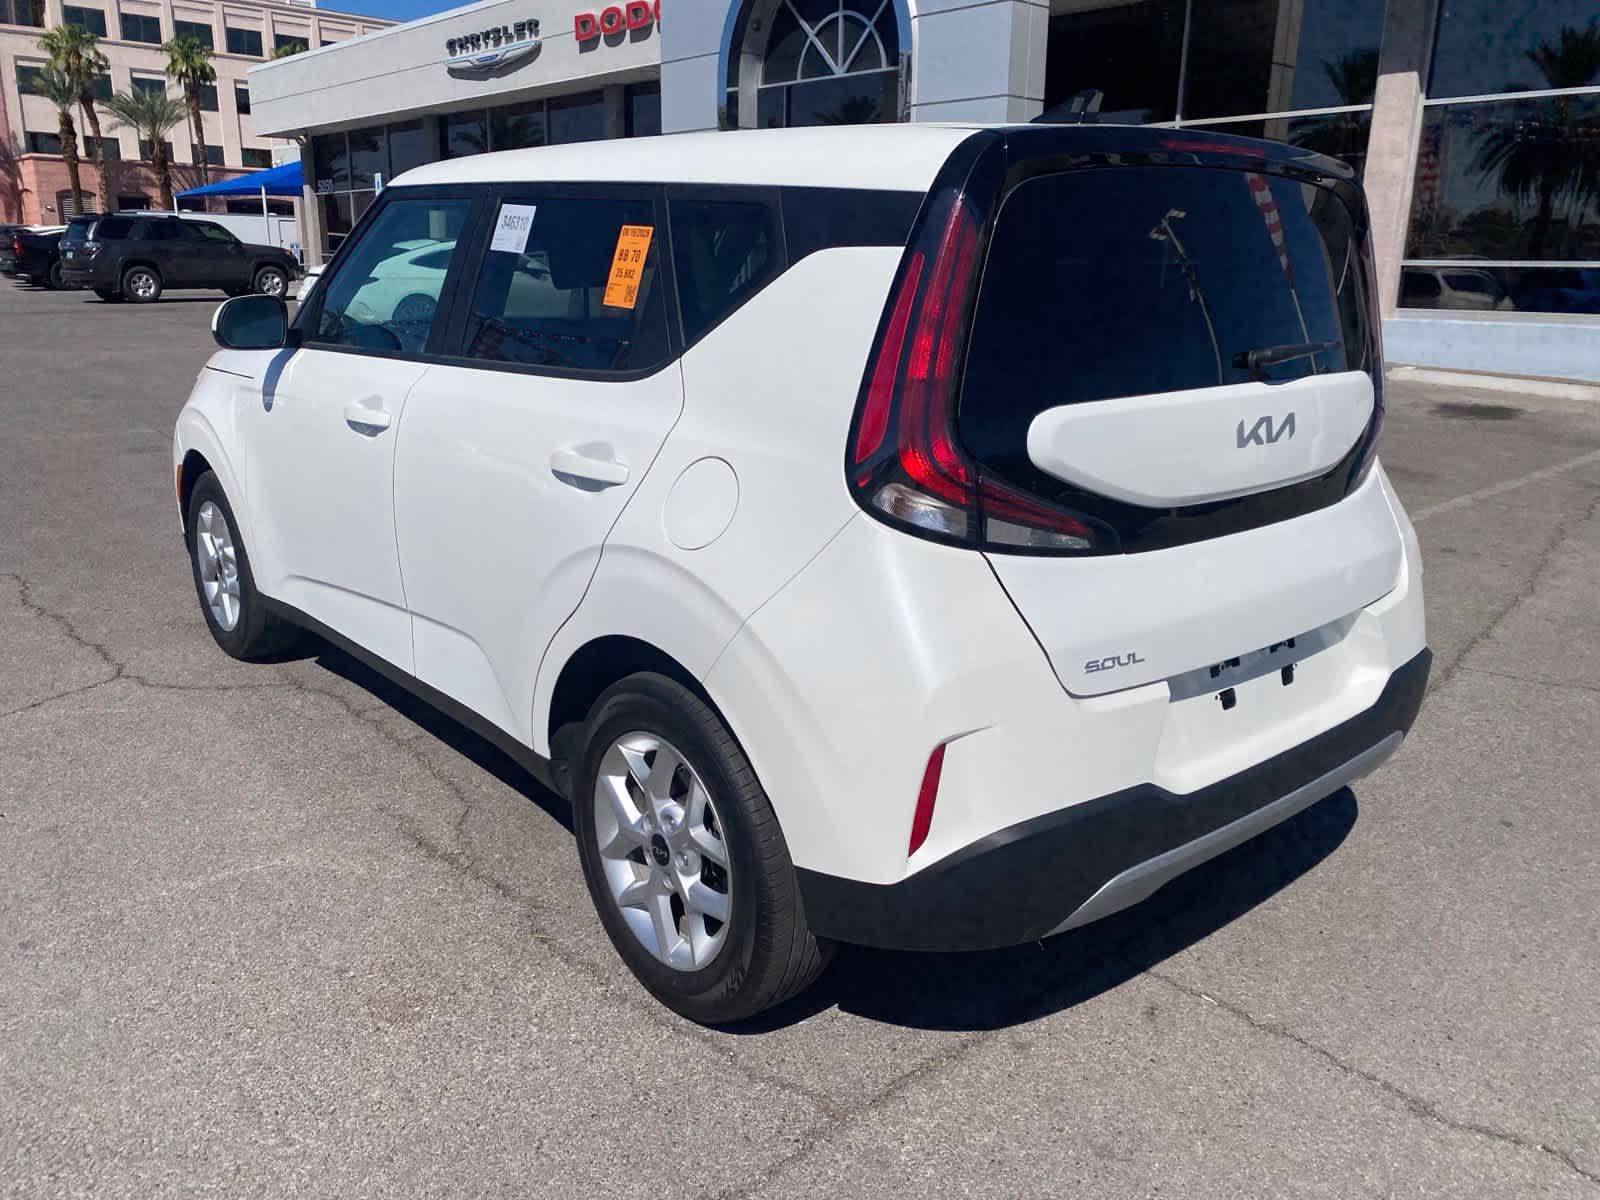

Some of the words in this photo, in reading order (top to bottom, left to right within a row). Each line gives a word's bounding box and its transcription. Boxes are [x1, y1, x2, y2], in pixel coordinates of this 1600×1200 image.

[446, 18, 540, 50] CHRYSLER
[574, 0, 661, 42] DOD
[1236, 412, 1296, 449] KIA
[1085, 652, 1145, 674] SOUL
